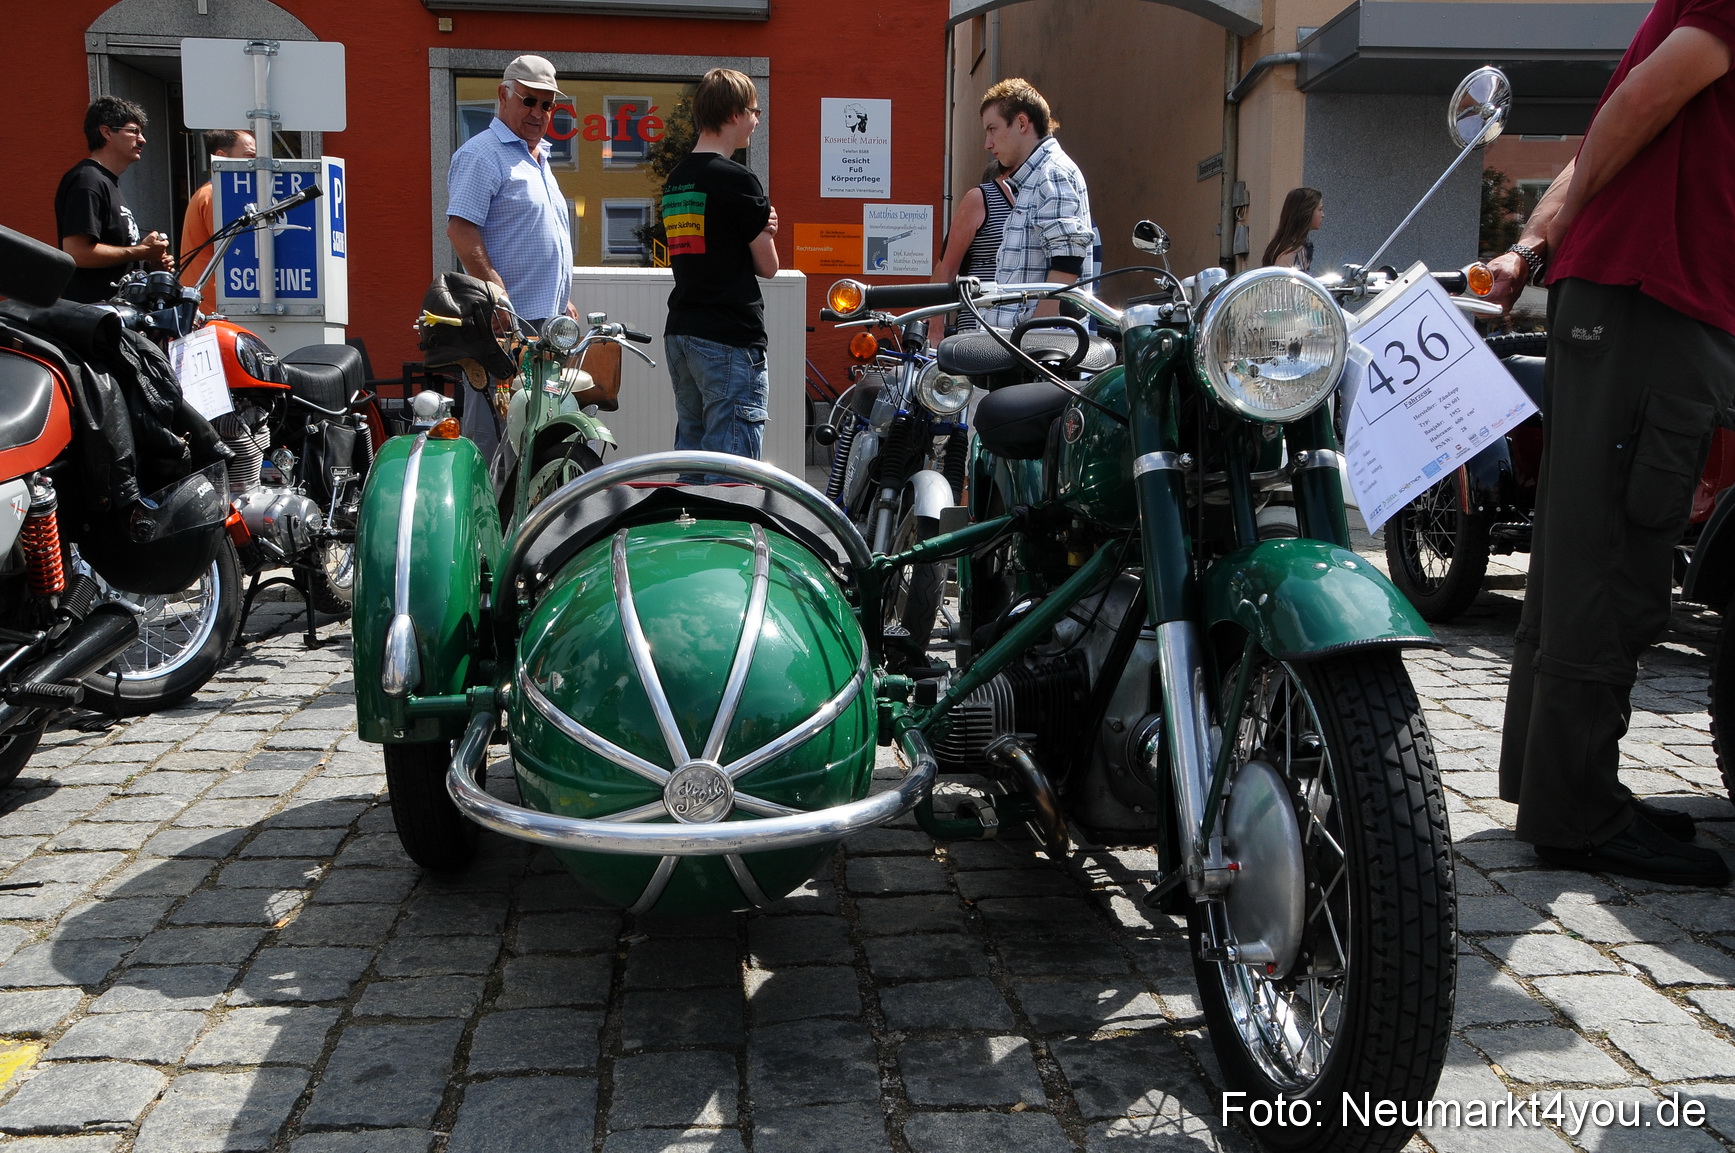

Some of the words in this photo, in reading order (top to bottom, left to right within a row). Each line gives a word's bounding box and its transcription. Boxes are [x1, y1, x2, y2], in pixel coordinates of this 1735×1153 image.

[545, 104, 664, 142] Café
[824, 134, 858, 144] Kosmetik
[860, 136, 888, 145] Marion
[234, 172, 303, 194] HER
[831, 175, 880, 183] Körperpflege
[334, 177, 342, 218] P
[869, 207, 898, 220] Matthias
[900, 208, 928, 222] Deppisch
[192, 350, 212, 376] 371
[1368, 316, 1450, 395] 436
[1404, 387, 1431, 408] Fahrzeug
[1413, 403, 1437, 420] Hersteller:
[1438, 387, 1459, 403] Zündapp
[1419, 419, 1430, 427] Typ:
[1424, 420, 1445, 435] Baujahr:
[1450, 408, 1461, 417] 1952
